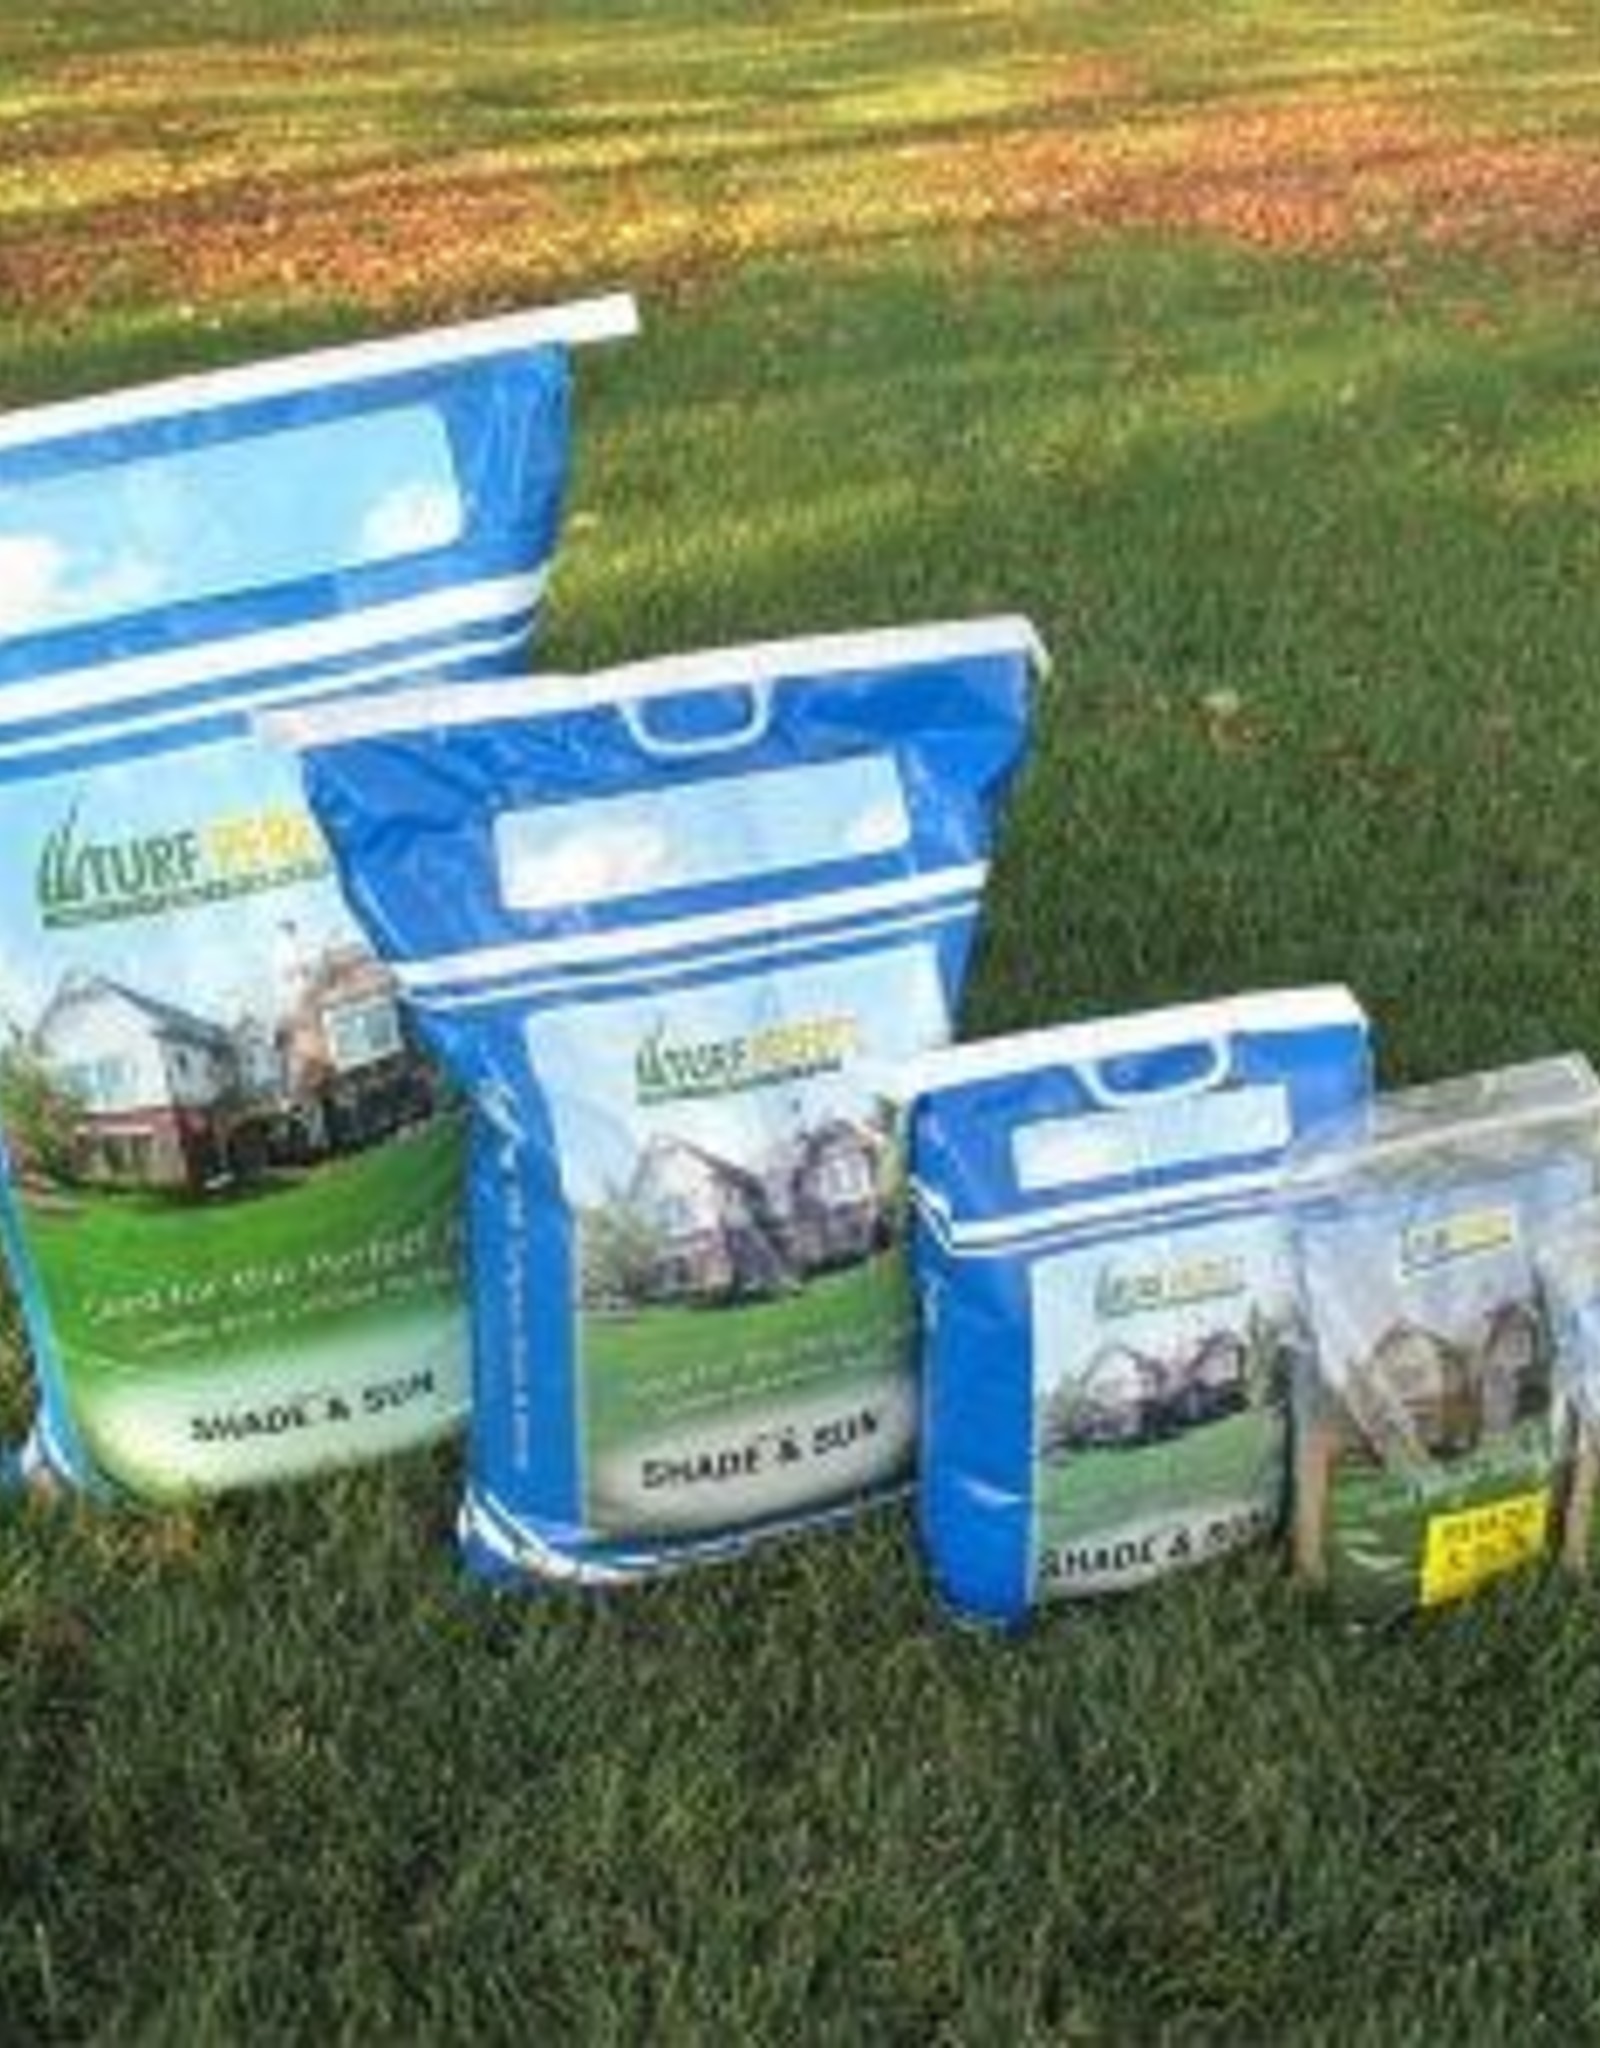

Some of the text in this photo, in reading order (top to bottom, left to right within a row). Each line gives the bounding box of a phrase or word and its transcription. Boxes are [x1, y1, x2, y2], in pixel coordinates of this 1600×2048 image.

[89, 830, 198, 897] TURF
[191, 1370, 435, 1441] SHADE & SUN
[641, 1409, 879, 1490] SHADE & SUN
[1037, 1535, 1156, 1578] SHADE
[1167, 1528, 1191, 1557] &
